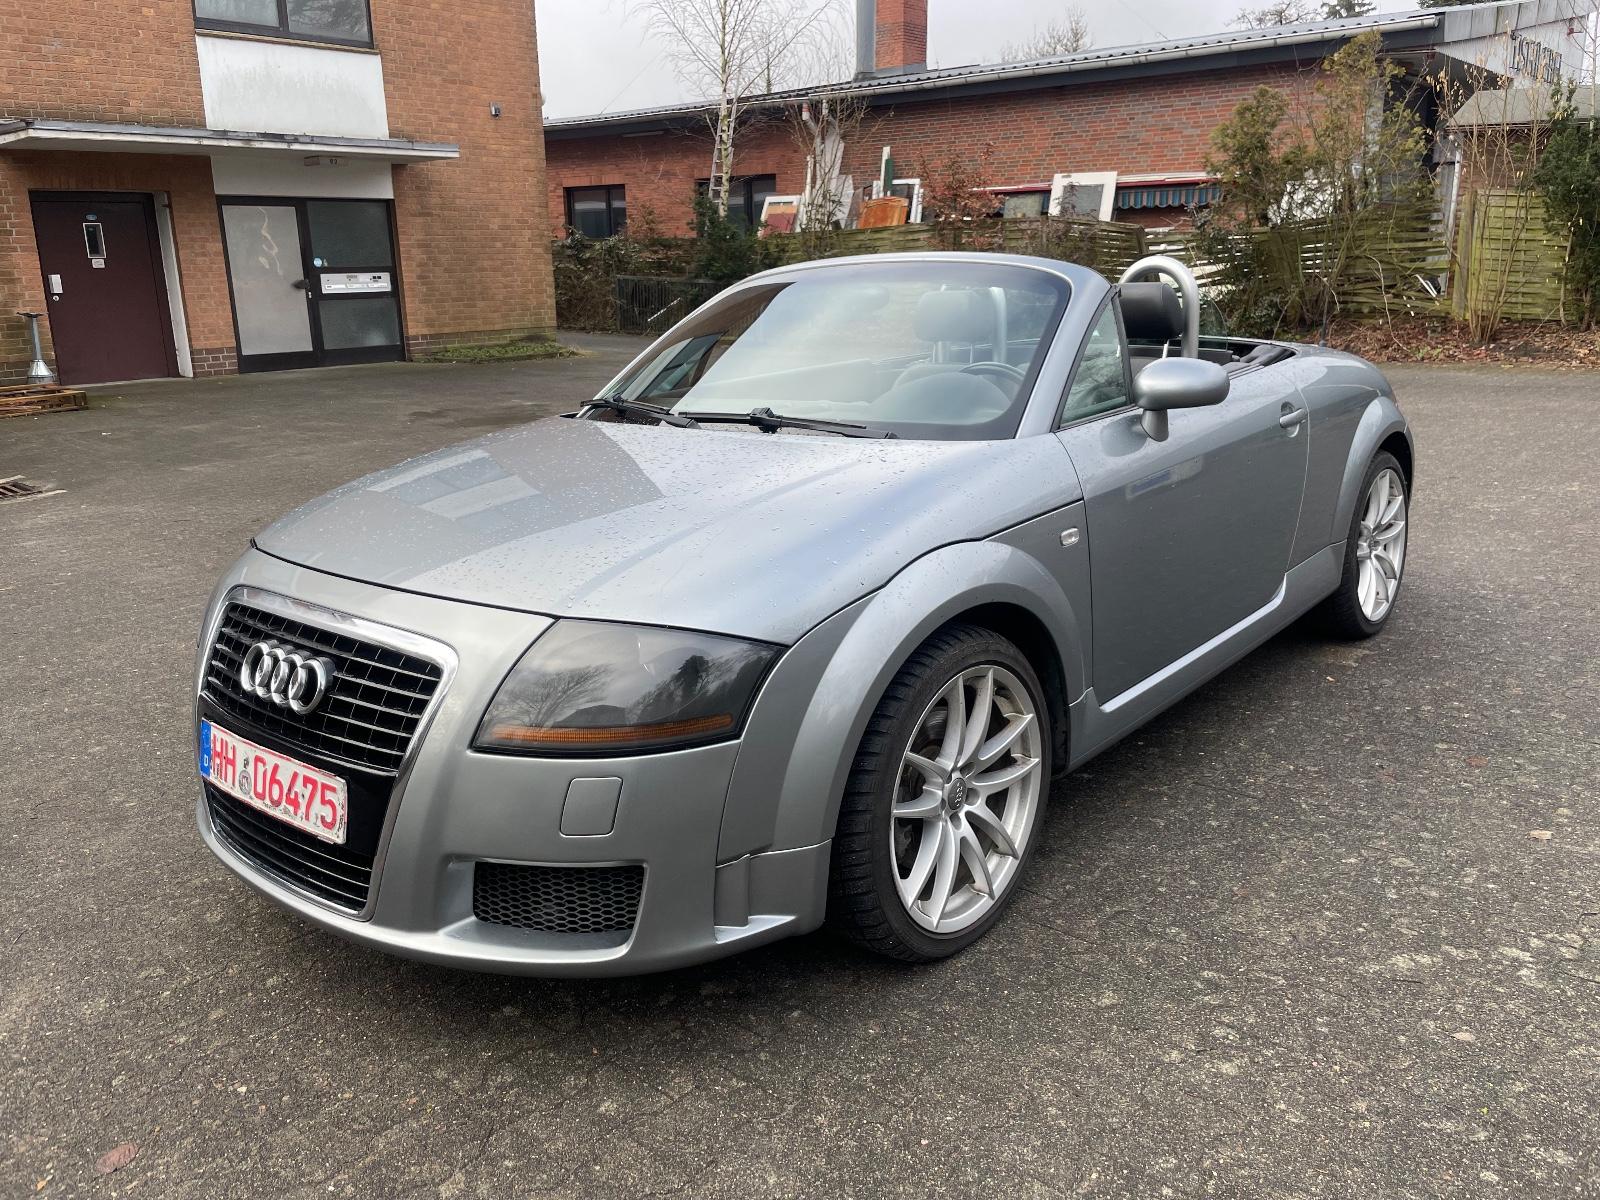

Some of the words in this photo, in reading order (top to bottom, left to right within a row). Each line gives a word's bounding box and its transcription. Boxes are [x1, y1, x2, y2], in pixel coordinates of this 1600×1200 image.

[203, 754, 209, 767] D
[212, 733, 236, 787] HH
[253, 754, 337, 830] 06475
